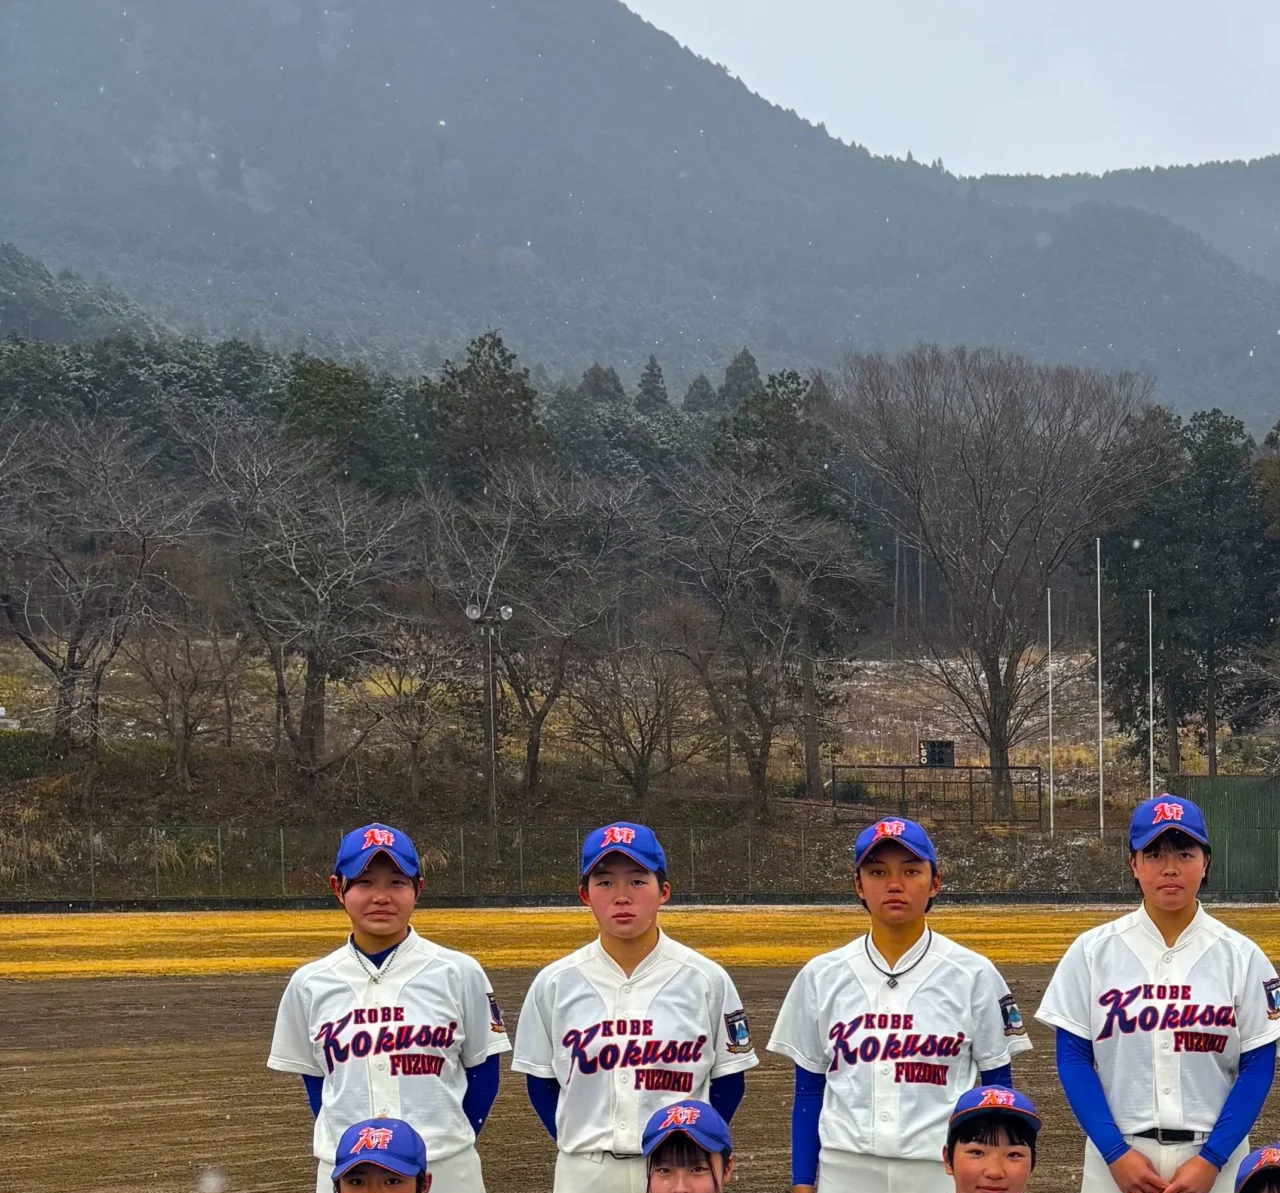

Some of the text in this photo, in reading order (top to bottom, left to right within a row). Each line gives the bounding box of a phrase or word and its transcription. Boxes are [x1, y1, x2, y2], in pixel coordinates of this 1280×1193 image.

[1143, 984, 1191, 1000] KOBE
[354, 1007, 404, 1024] KOBE
[601, 1019, 653, 1037] KOBE
[864, 1013, 913, 1030] KOBE
[1095, 985, 1237, 1042] Kokusa
[314, 1011, 458, 1075] Kokusai
[562, 1023, 707, 1085] Kokusai
[828, 1015, 965, 1073] Kokusai
